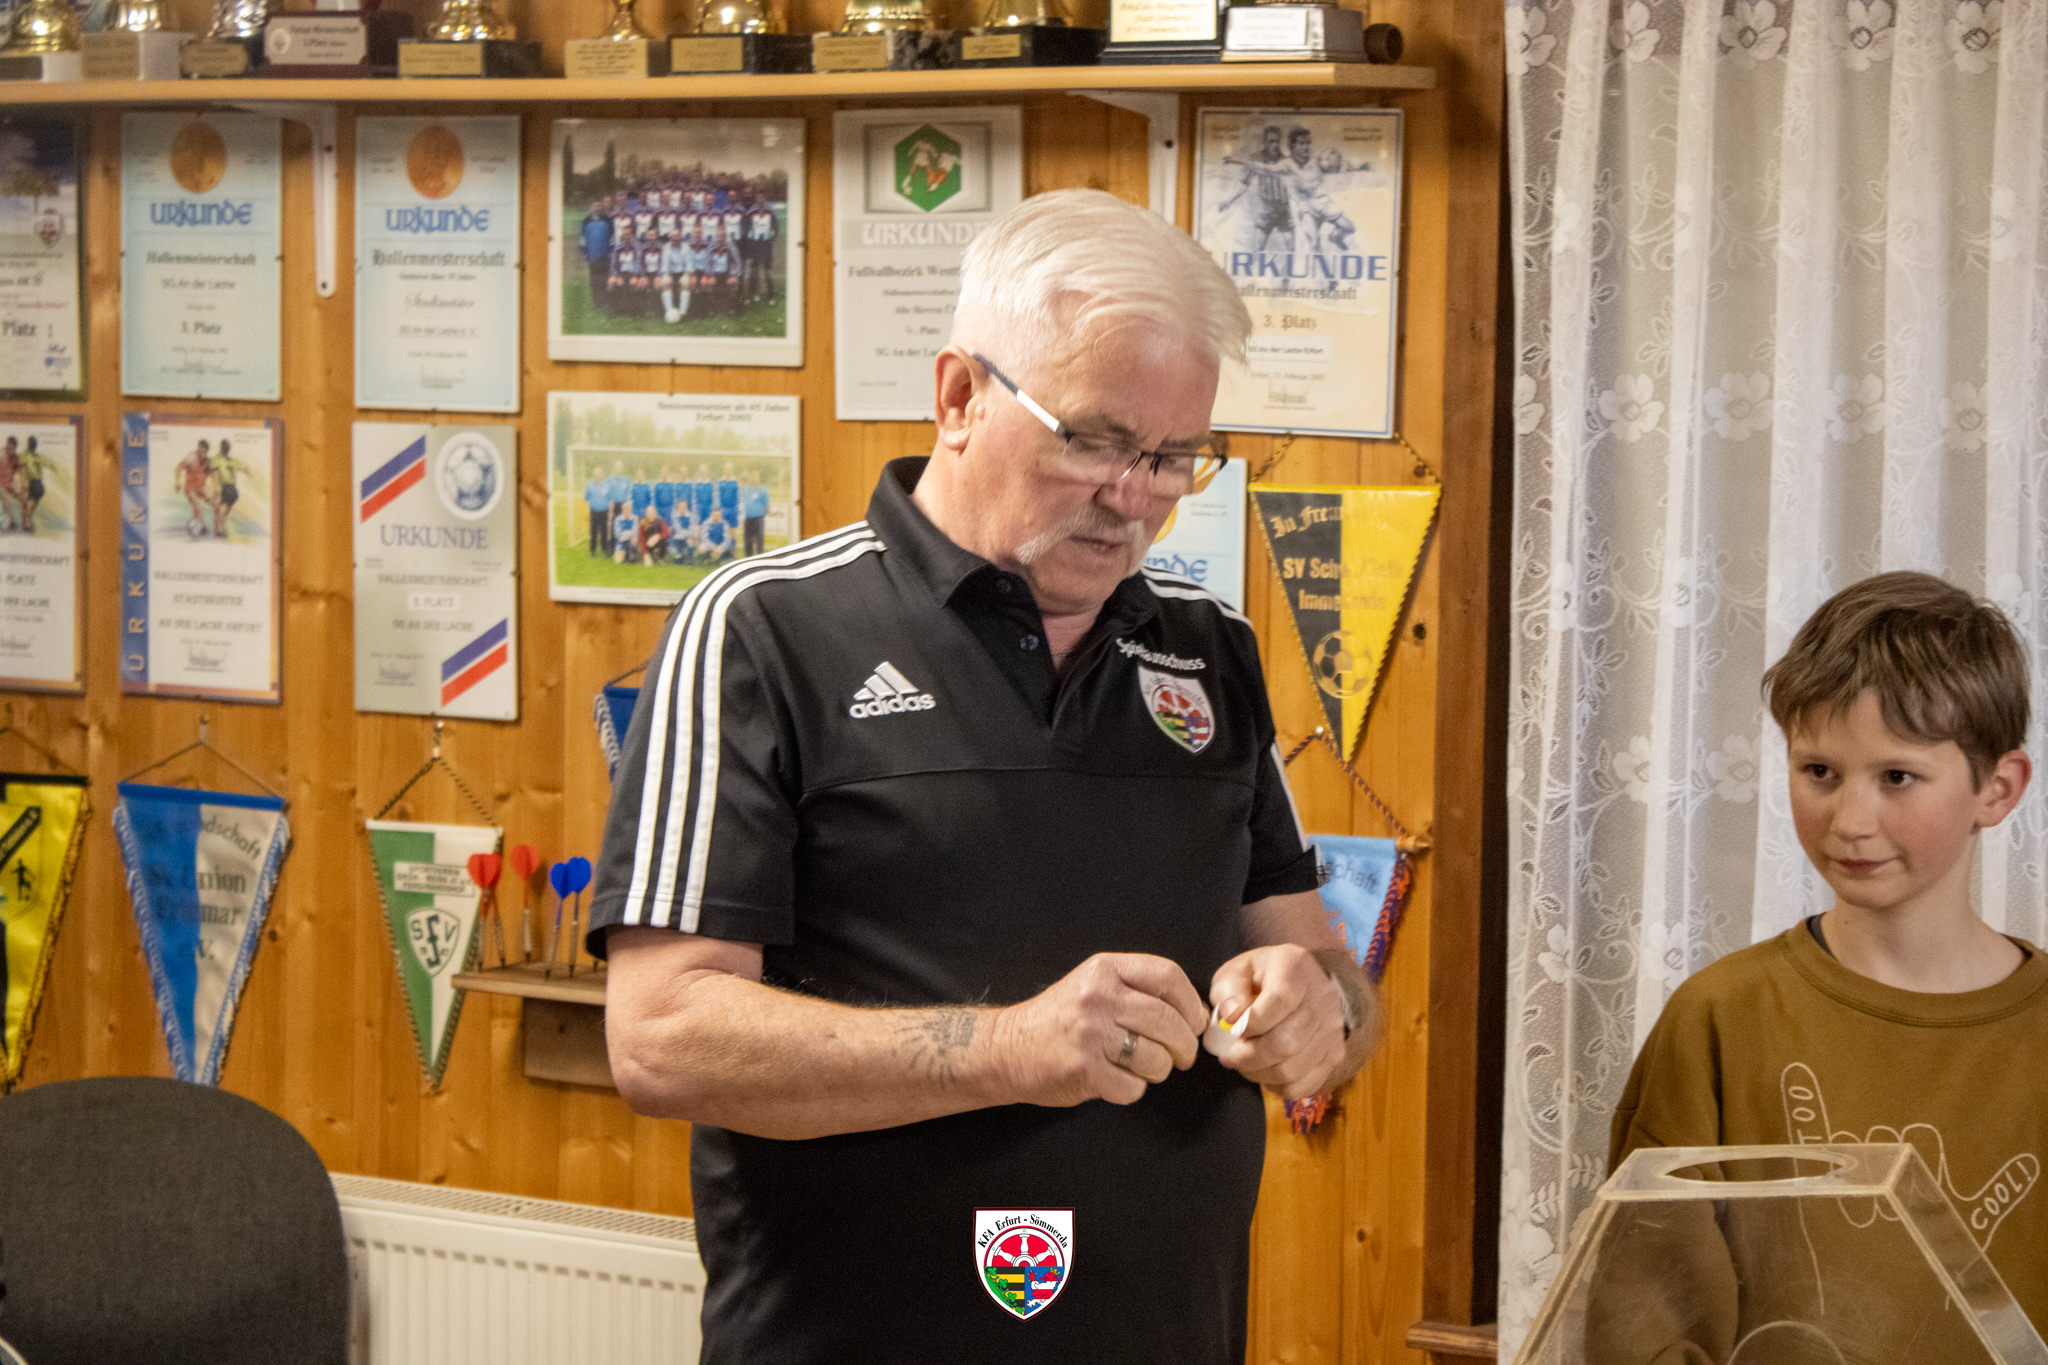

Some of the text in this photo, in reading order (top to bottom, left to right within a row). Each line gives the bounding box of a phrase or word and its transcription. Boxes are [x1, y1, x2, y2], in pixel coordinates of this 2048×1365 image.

[848, 265, 924, 279] Fußballbezirk
[1223, 251, 1388, 282] RKUNDE
[912, 304, 943, 316] Herren
[2, 320, 38, 338] Platz
[194, 321, 222, 335] Platz
[1262, 313, 1317, 331] 3. Platz
[379, 524, 490, 550] URKUNDE
[127, 430, 148, 673] URKUNDE
[1282, 557, 1306, 580] SV
[424, 597, 455, 609] PLATZ
[194, 619, 224, 632] LACHE
[849, 692, 937, 719] adidas
[1788, 1085, 1824, 1147] TOO
[1969, 1160, 2033, 1231] COOL!
